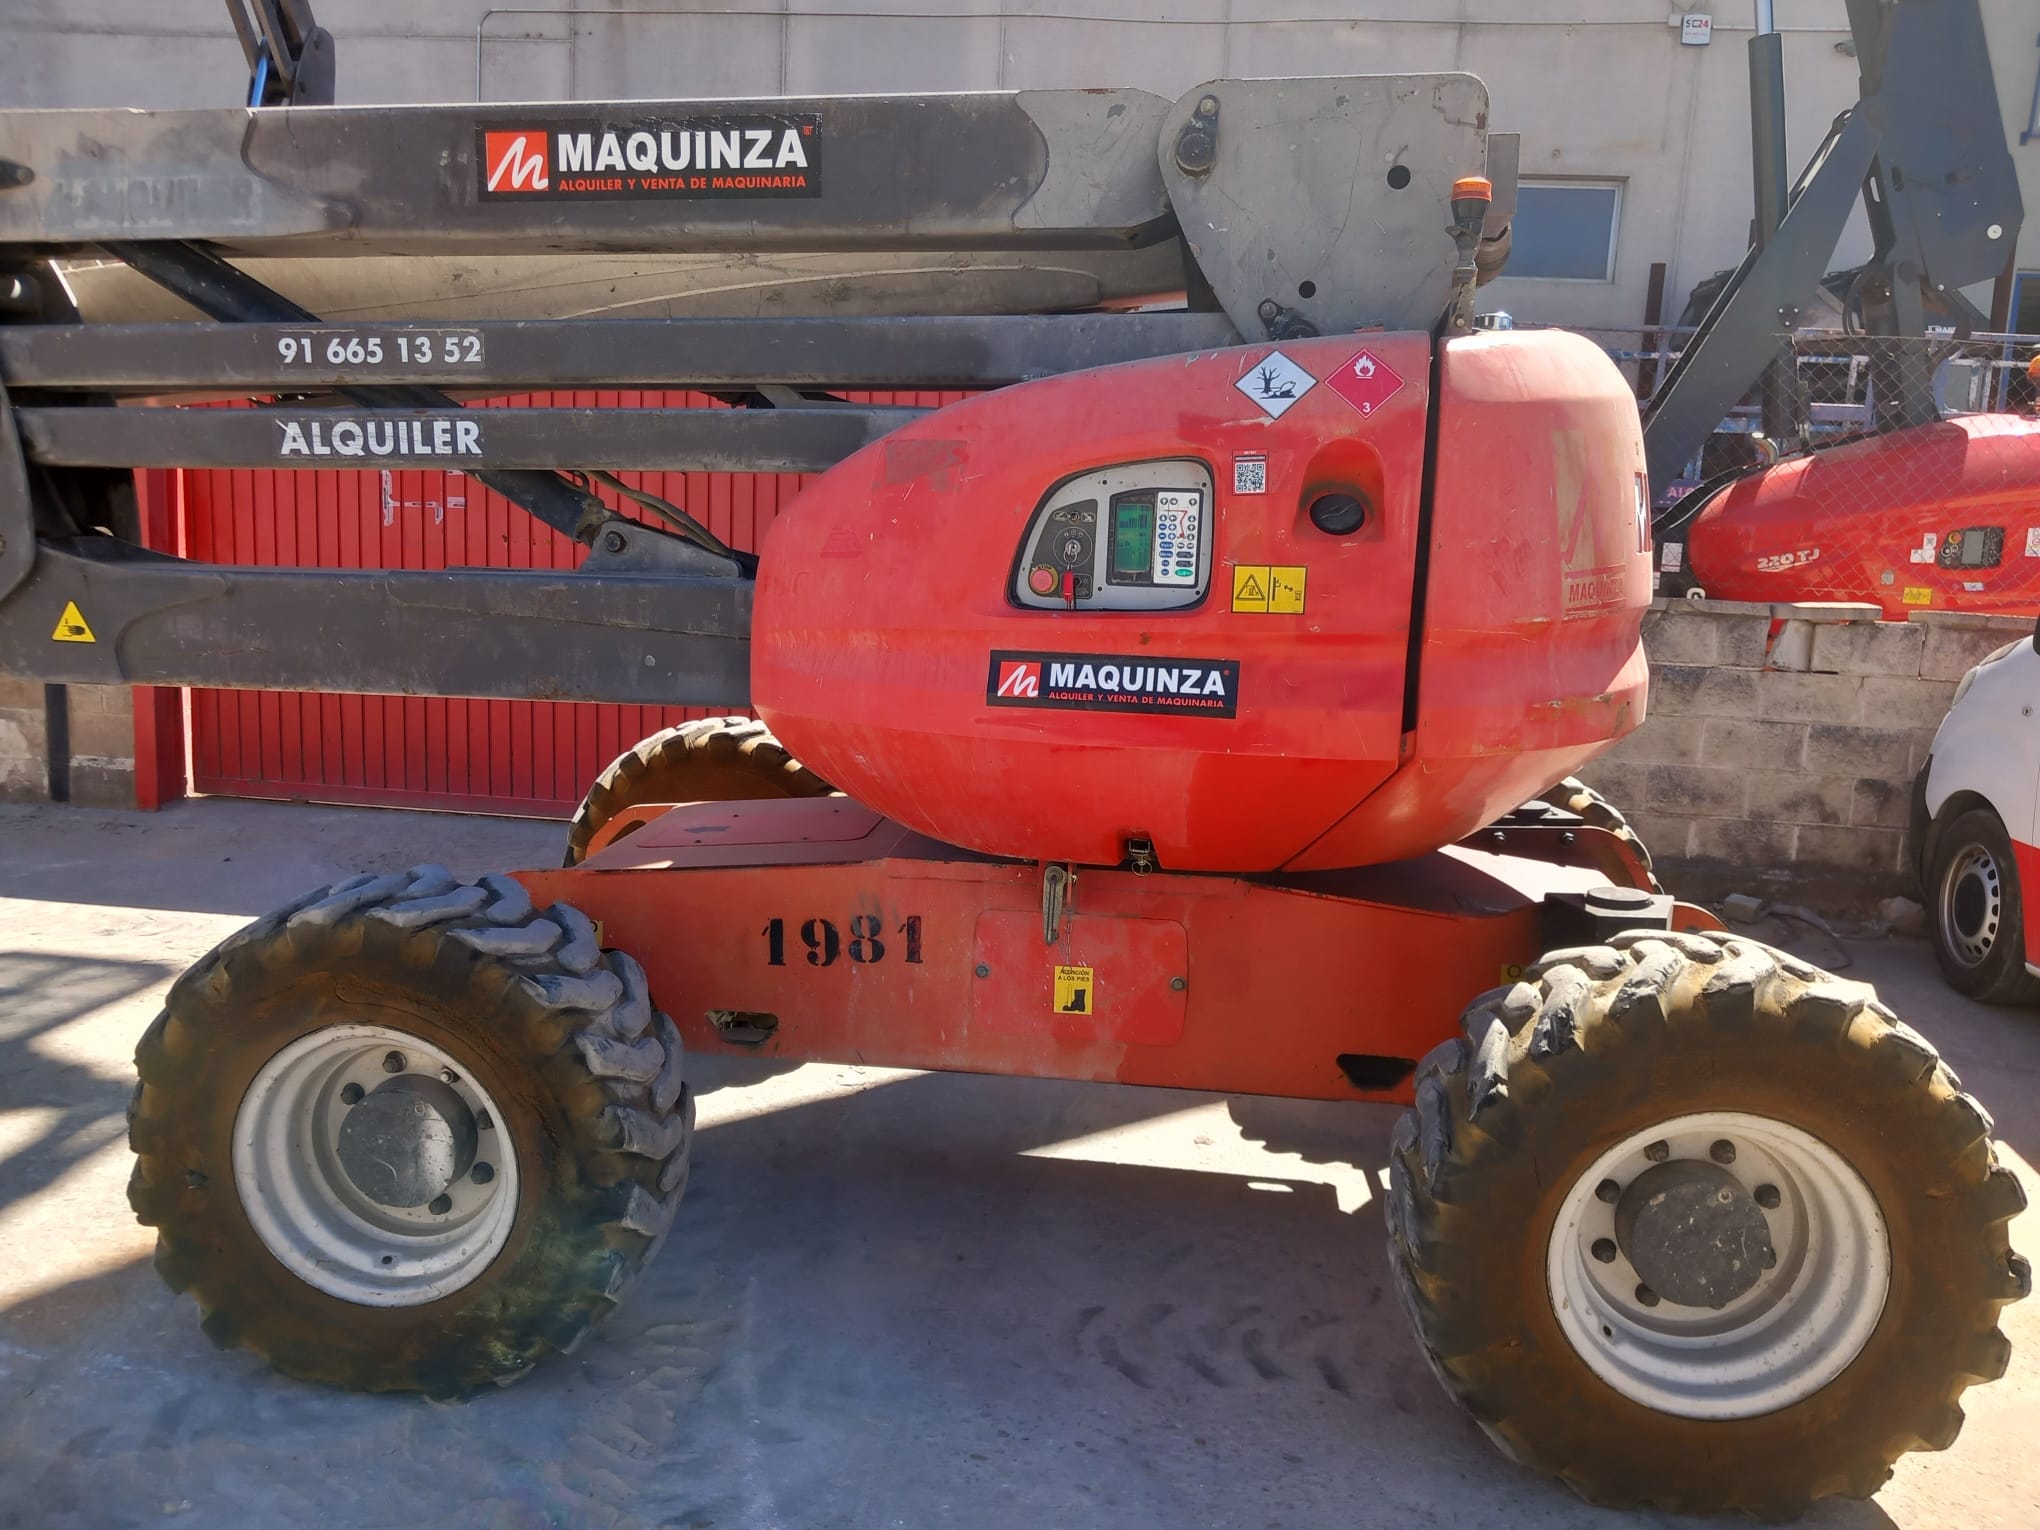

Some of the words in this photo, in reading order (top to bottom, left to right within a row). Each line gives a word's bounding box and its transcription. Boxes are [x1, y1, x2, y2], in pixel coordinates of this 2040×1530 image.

[1685, 19, 1708, 28] SC24
[558, 129, 808, 174] MAQUINZA
[559, 179, 622, 191] ALQUILER
[628, 178, 636, 190] Y
[641, 178, 685, 190] VENTA
[690, 177, 707, 189] DE
[712, 176, 807, 189] MAQUINARIA
[278, 337, 312, 364] 91
[326, 337, 383, 364] 665
[397, 336, 433, 364] 13
[444, 336, 482, 363] 52
[1362, 402, 1371, 413] 3
[280, 420, 482, 456] ALQUILER
[1757, 553, 1794, 569] 220
[1797, 548, 1820, 562] TJ
[1049, 663, 1225, 696] MAQUINZA
[1048, 691, 1094, 701] ALQUILER
[1097, 694, 1104, 702] Y
[1107, 694, 1138, 703] VENTA
[1142, 696, 1154, 704] DE
[1157, 697, 1224, 708] MAQUINARIA
[761, 915, 923, 966] 1981
